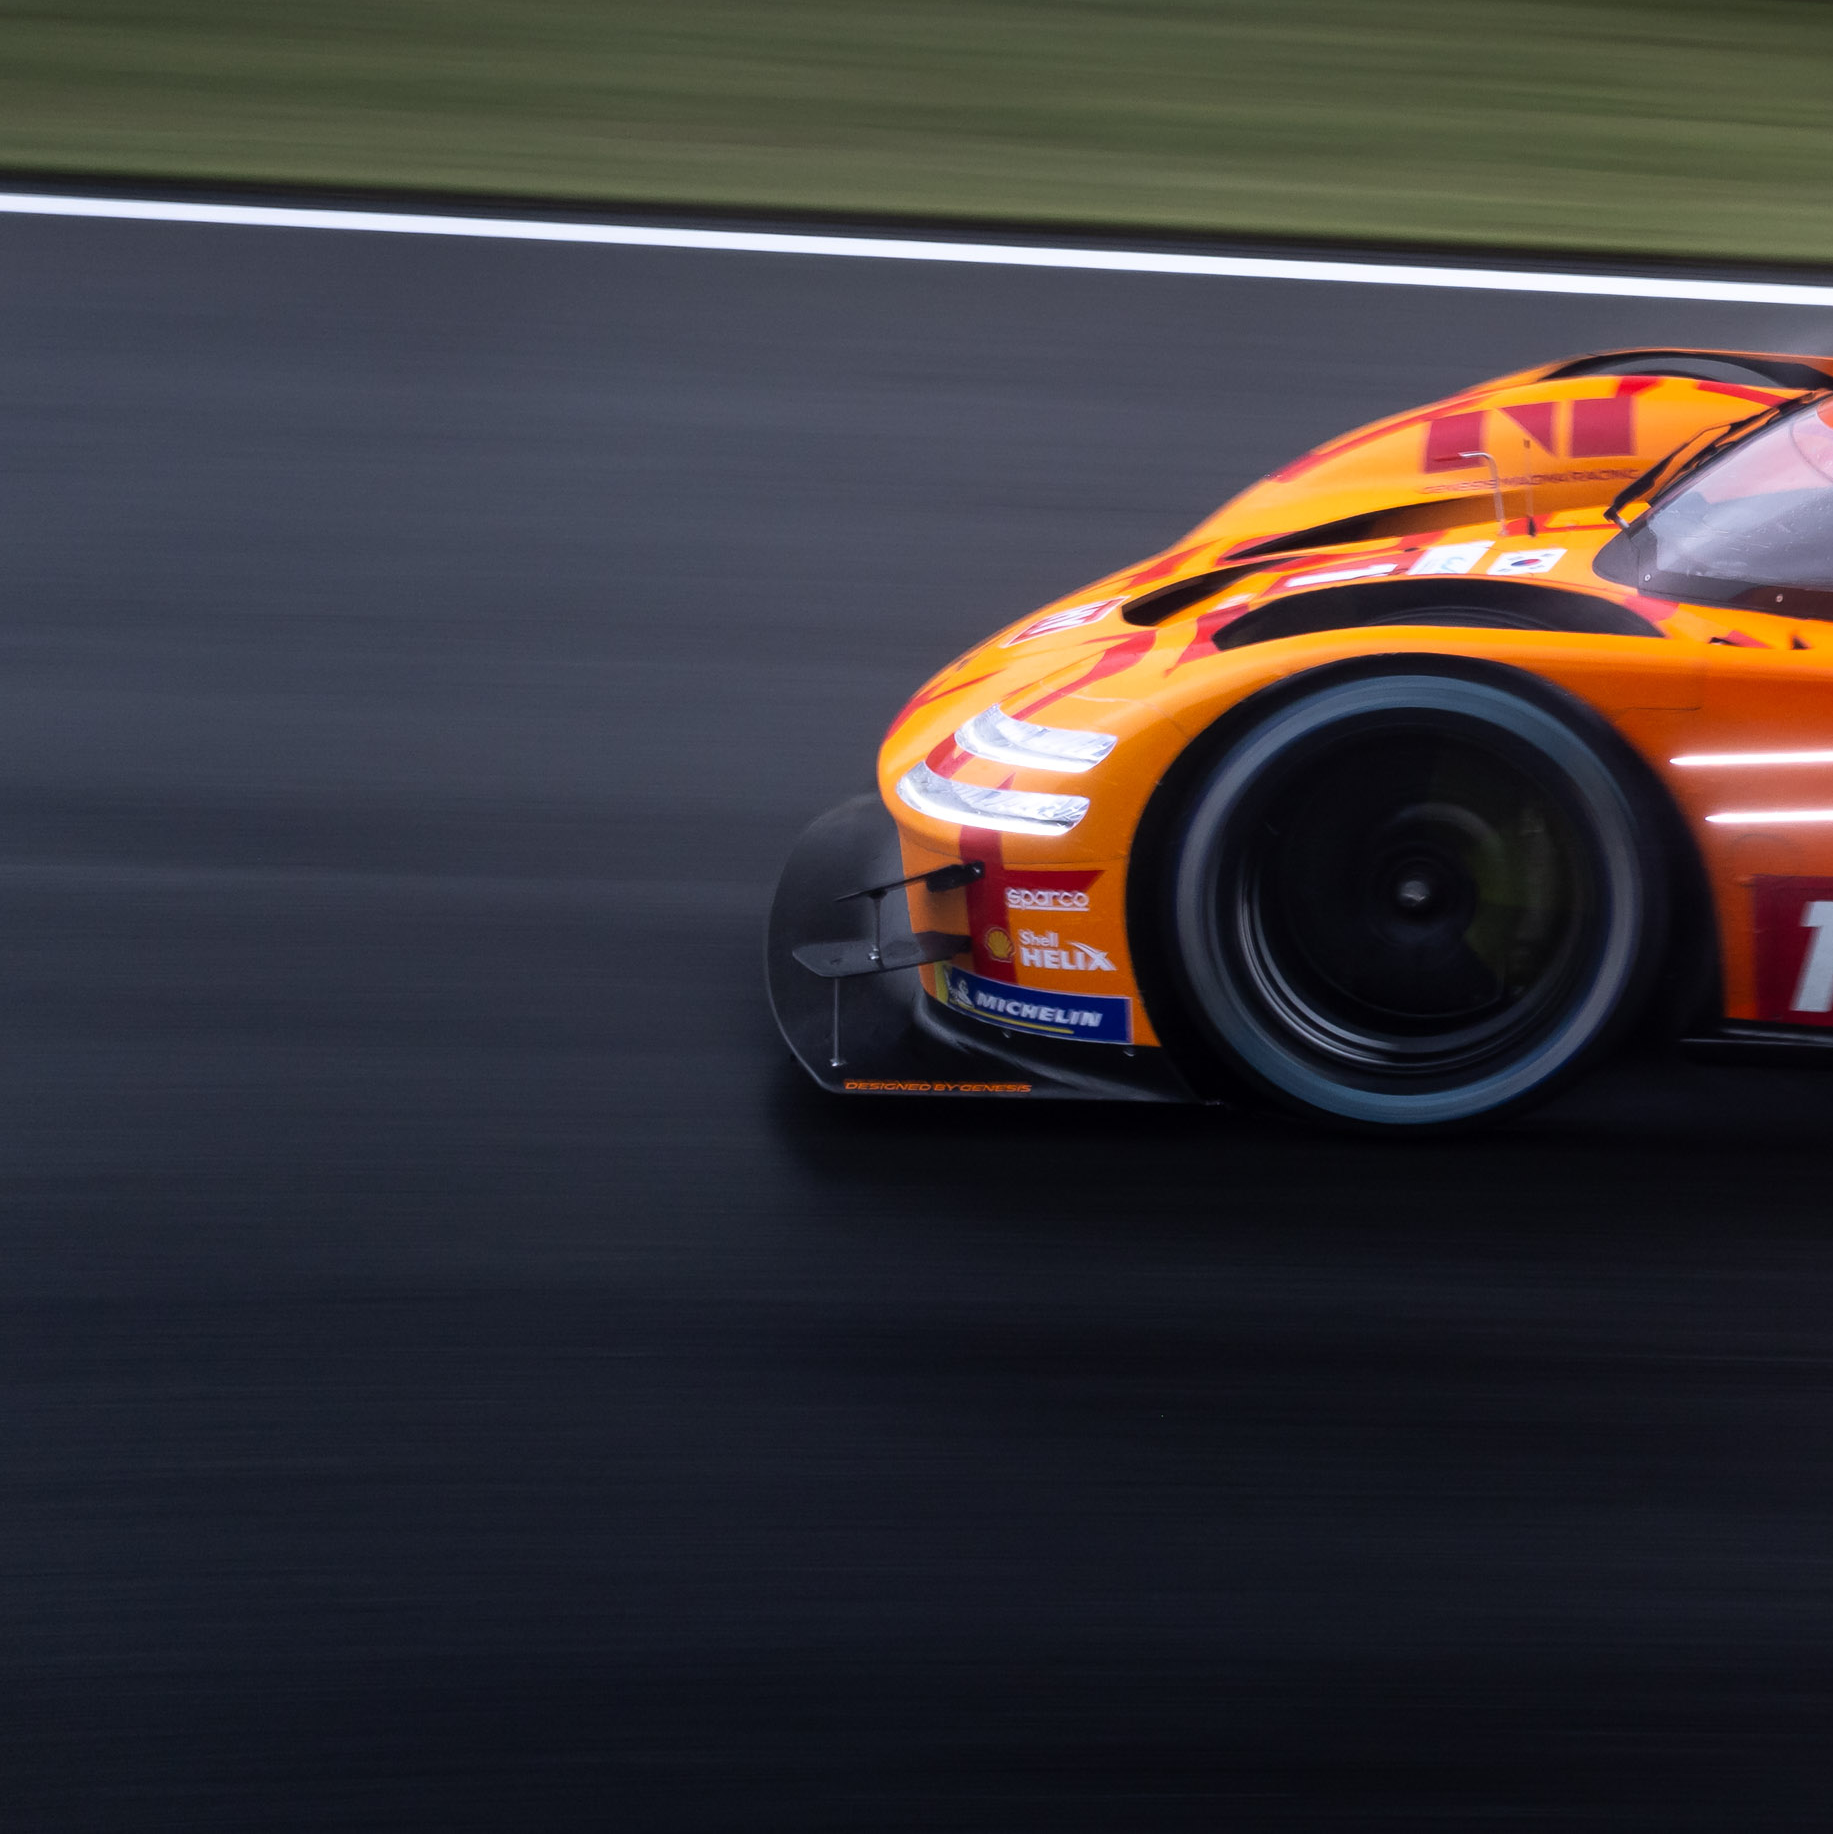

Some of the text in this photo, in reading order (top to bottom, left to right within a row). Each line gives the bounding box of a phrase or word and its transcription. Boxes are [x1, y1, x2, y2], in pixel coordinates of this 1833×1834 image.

[1005, 888, 1090, 910] sparco
[1019, 929, 1058, 948] Shell
[1020, 941, 1117, 971] HELIX
[976, 990, 1103, 1027] MICHELIN
[845, 1080, 1033, 1093] DESIGNED BY GENESIS
